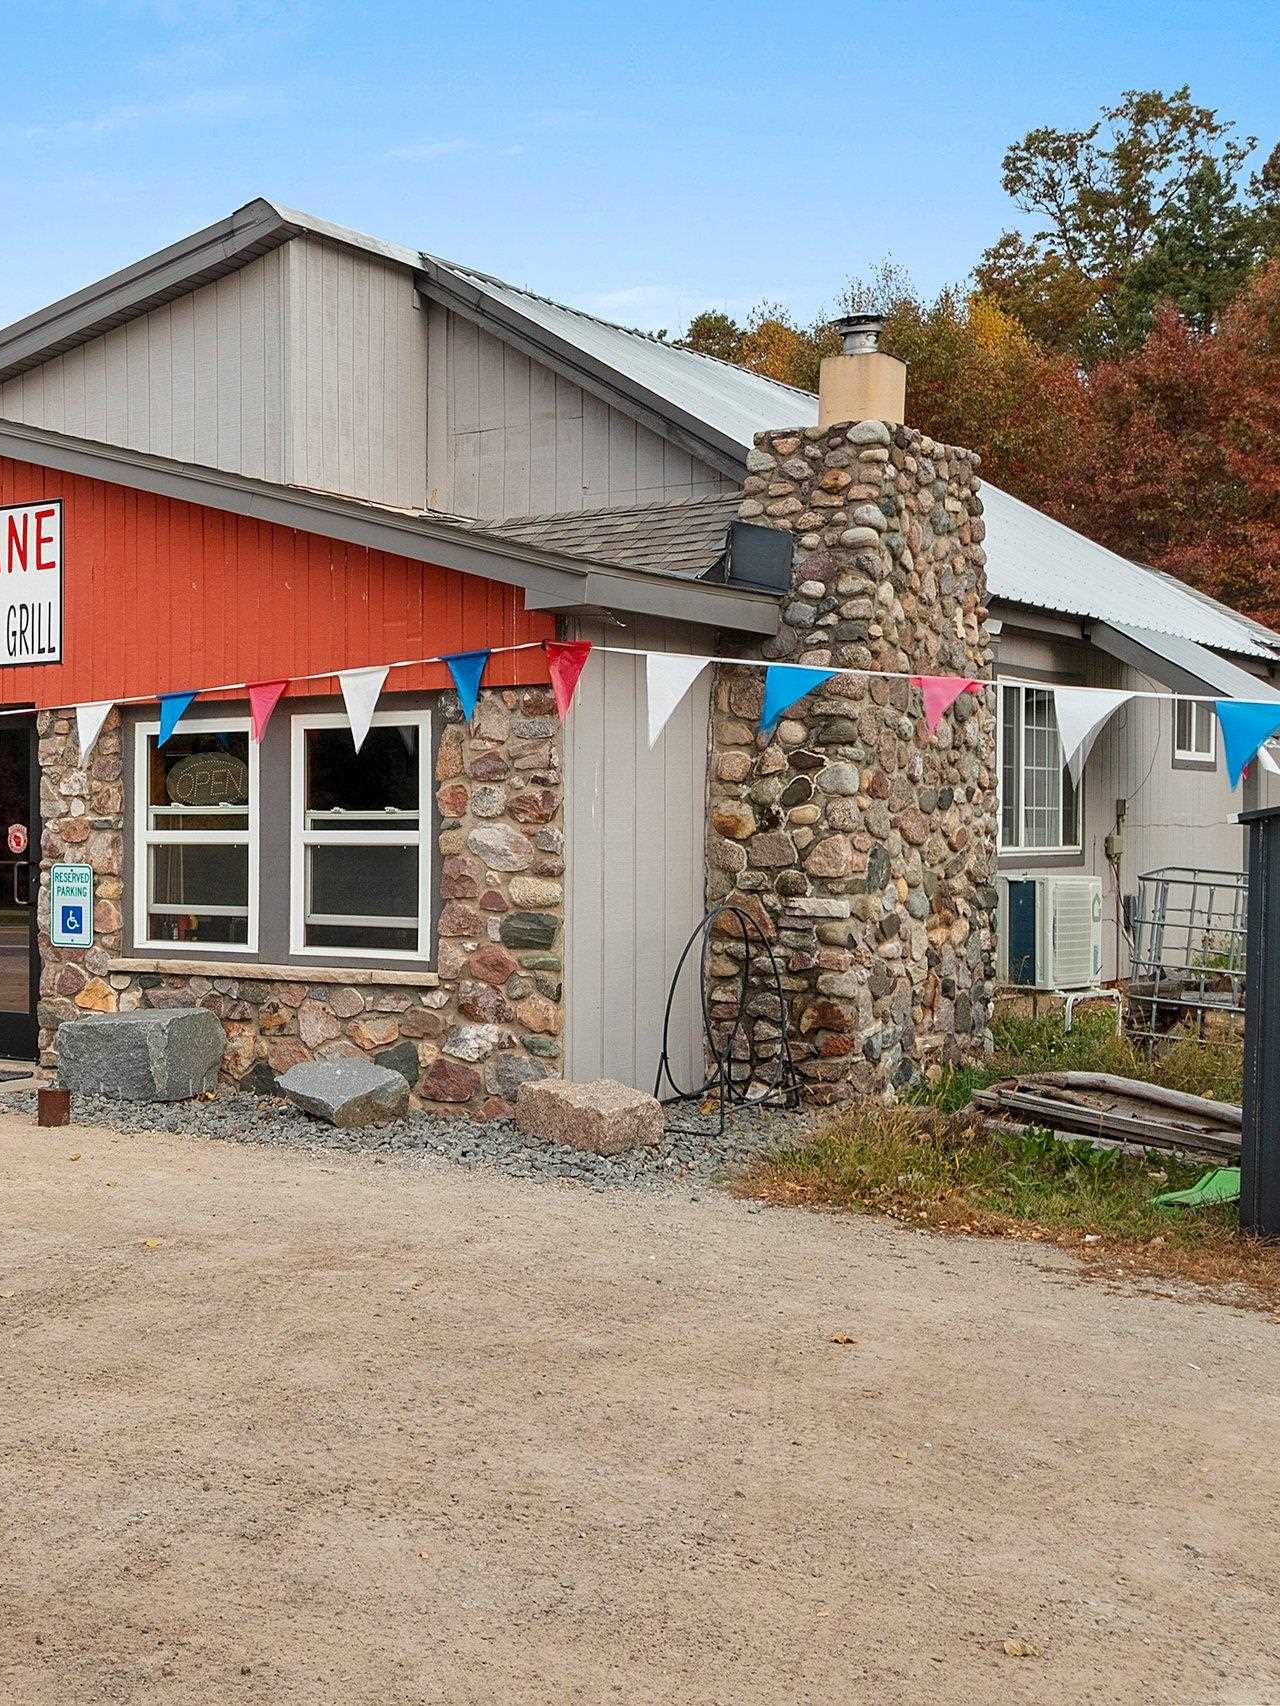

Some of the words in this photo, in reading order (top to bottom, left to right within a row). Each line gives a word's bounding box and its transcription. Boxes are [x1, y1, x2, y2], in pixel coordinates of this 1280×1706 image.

[6, 601, 56, 657] GRILL
[176, 769, 243, 798] OPEN
[55, 872, 90, 883] RESERVED
[56, 886, 88, 897] PARKING
